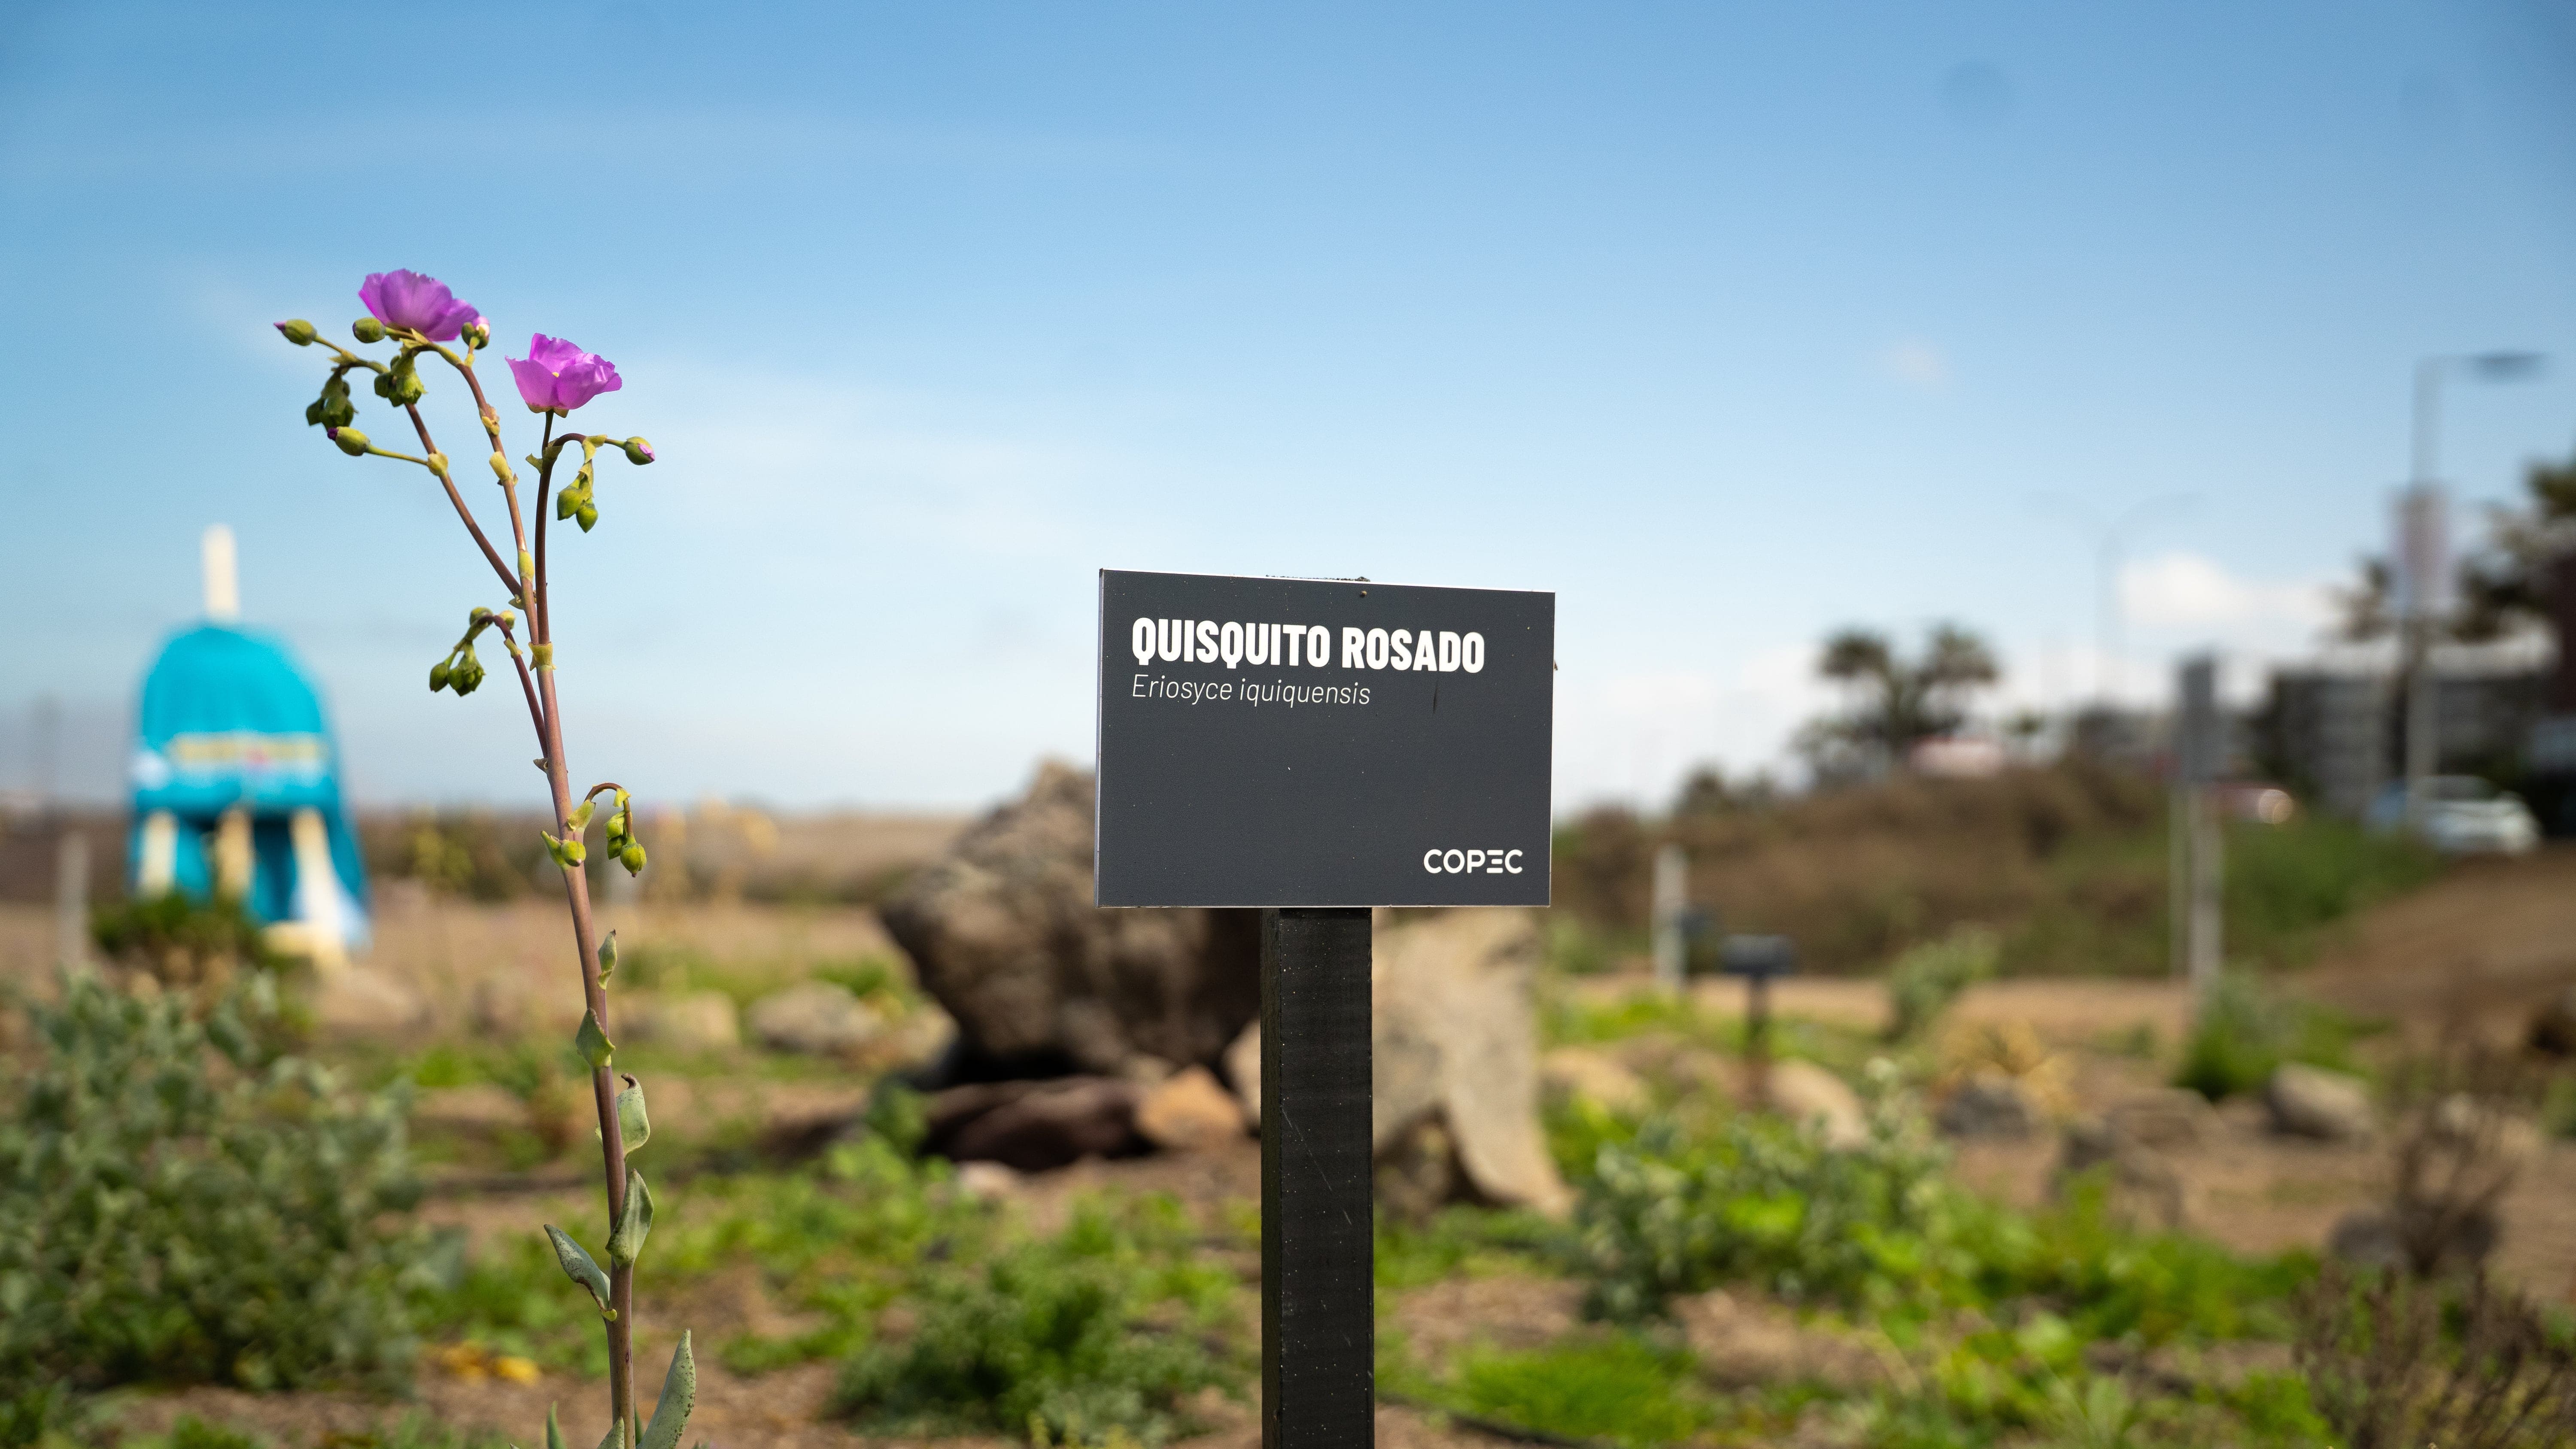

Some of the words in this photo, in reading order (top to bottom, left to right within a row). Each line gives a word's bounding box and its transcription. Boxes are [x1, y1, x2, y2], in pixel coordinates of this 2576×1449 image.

[1132, 617, 1331, 670] QUISQUITO
[1341, 626, 1485, 674] ROSADO
[1132, 673, 1233, 706] Eriosyce
[1239, 677, 1371, 709] iquiquensis
[1423, 848, 1523, 874] COPEC
